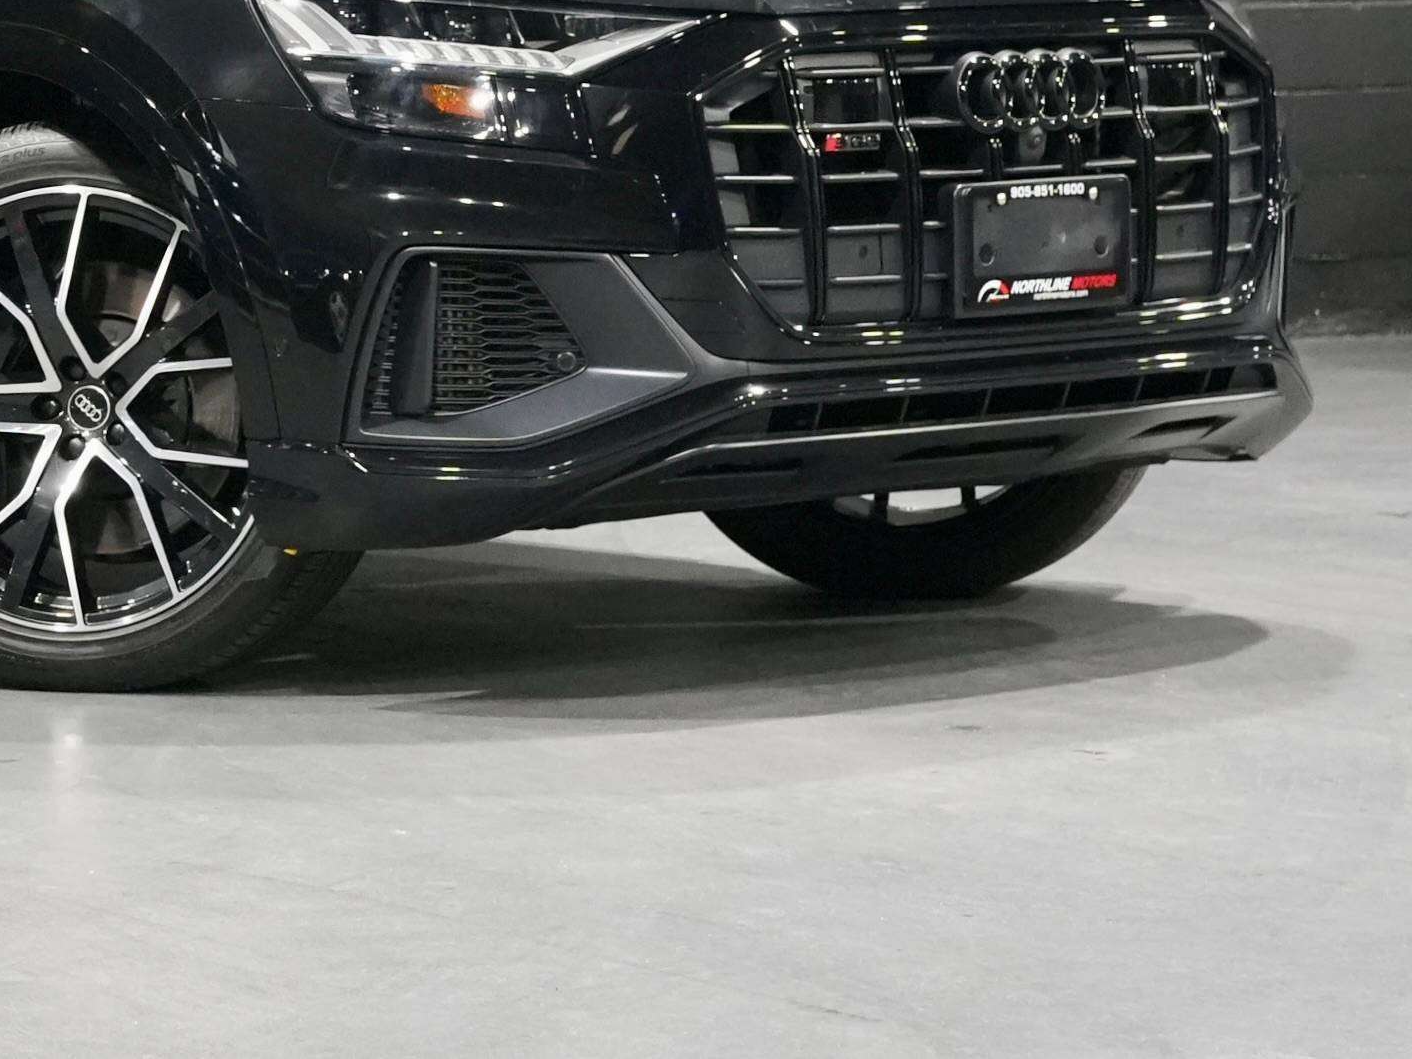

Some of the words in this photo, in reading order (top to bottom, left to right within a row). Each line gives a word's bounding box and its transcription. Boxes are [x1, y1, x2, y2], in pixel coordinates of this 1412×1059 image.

[1010, 182, 1085, 199] 905-851-1600
[1011, 276, 1072, 295] NORTHLINE
[1071, 273, 1117, 290] MOTORS
